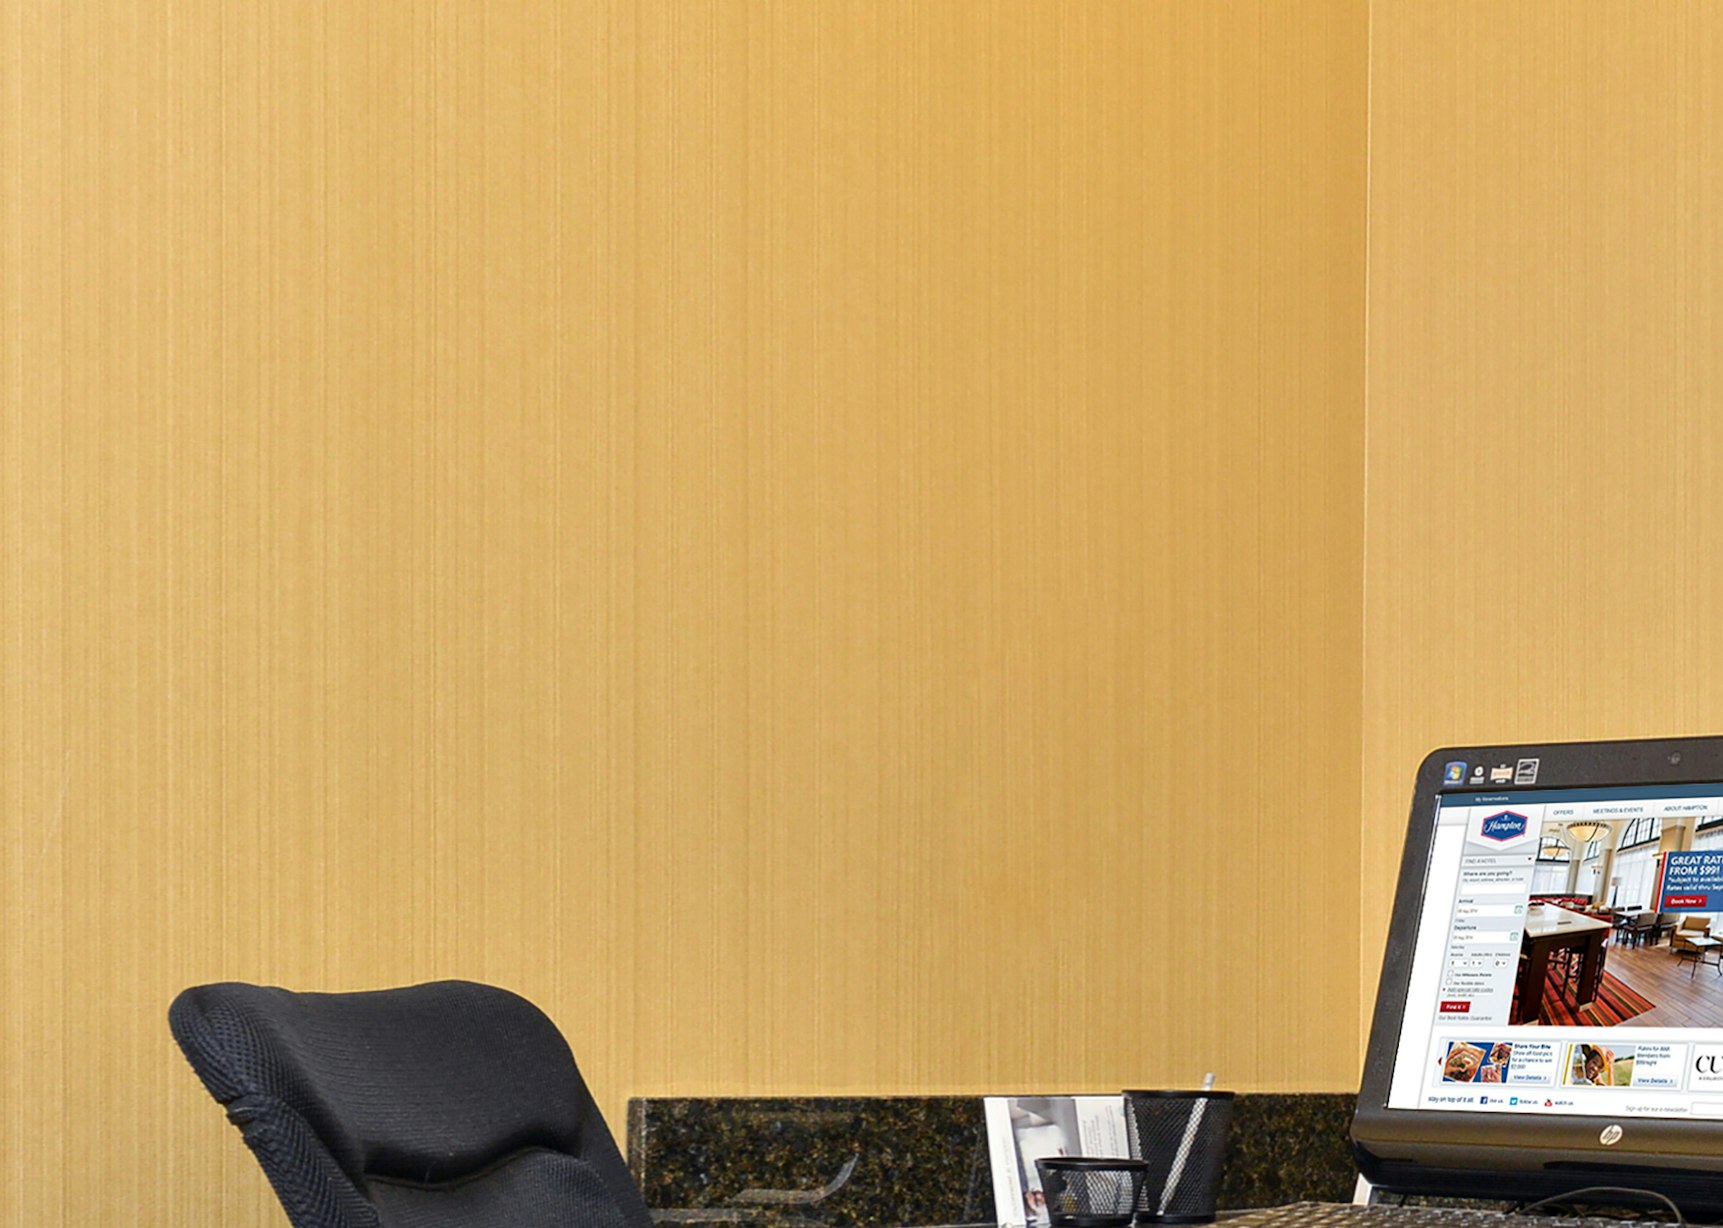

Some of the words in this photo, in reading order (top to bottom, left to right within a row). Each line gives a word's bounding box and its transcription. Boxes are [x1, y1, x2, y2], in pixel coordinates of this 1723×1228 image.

[1483, 820, 1525, 834] Hampton
[1670, 856, 1702, 866] GREAT
[1669, 866, 1698, 876] FROM
[1700, 866, 1720, 876] $99!
